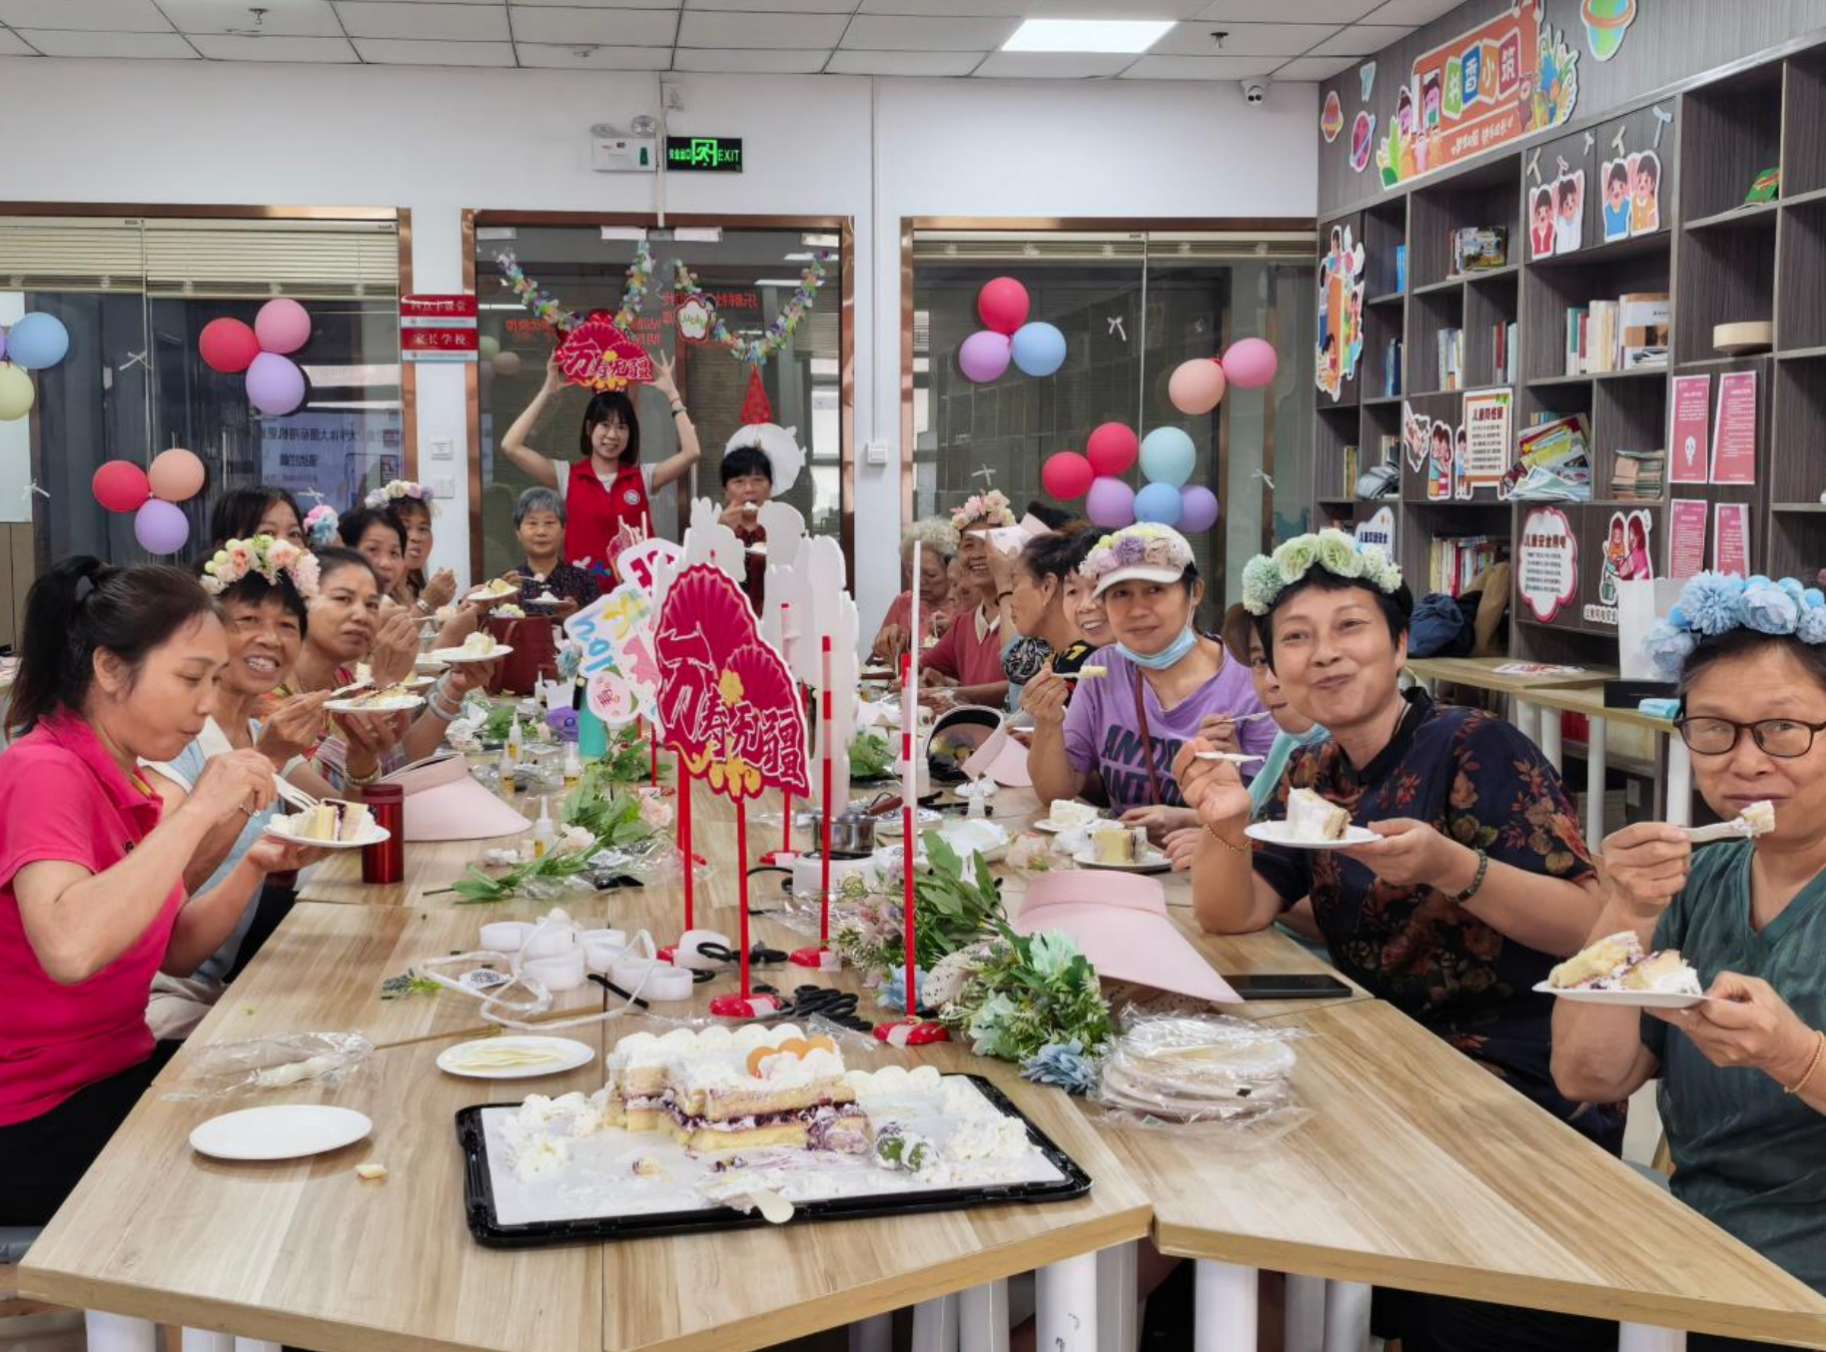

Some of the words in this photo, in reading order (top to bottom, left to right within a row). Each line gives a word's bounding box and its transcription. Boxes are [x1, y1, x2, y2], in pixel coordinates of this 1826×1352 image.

[718, 149, 740, 161] EXIT
[413, 333, 466, 345] 家长学校
[563, 338, 652, 379] 万寿无疆
[656, 621, 805, 788] 万寿无疆
